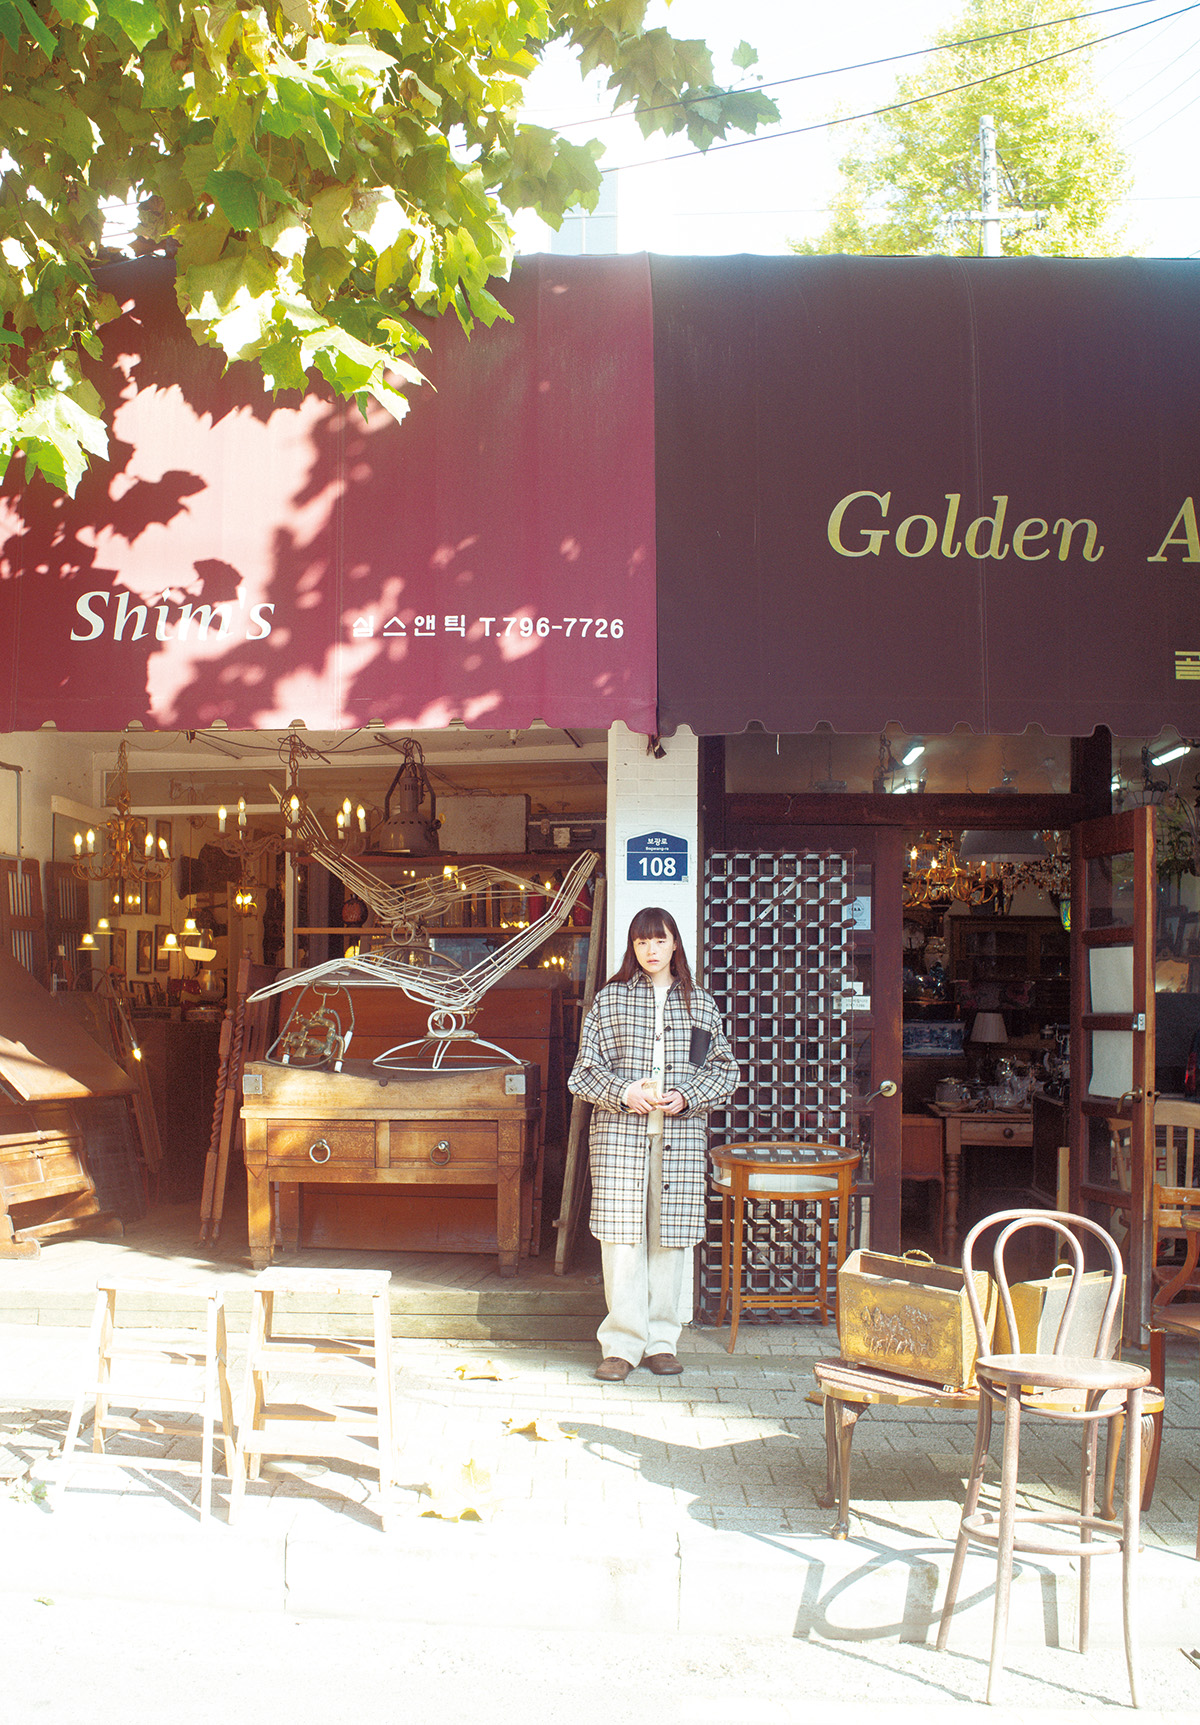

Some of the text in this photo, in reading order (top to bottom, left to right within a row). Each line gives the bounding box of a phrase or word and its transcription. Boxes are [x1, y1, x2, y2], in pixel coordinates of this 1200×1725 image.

[827, 490, 1104, 562] Golden
[70, 587, 275, 641] Shim's
[479, 617, 624, 638] T.796-7726
[647, 838, 668, 846] 보광로
[638, 857, 676, 877] 108
